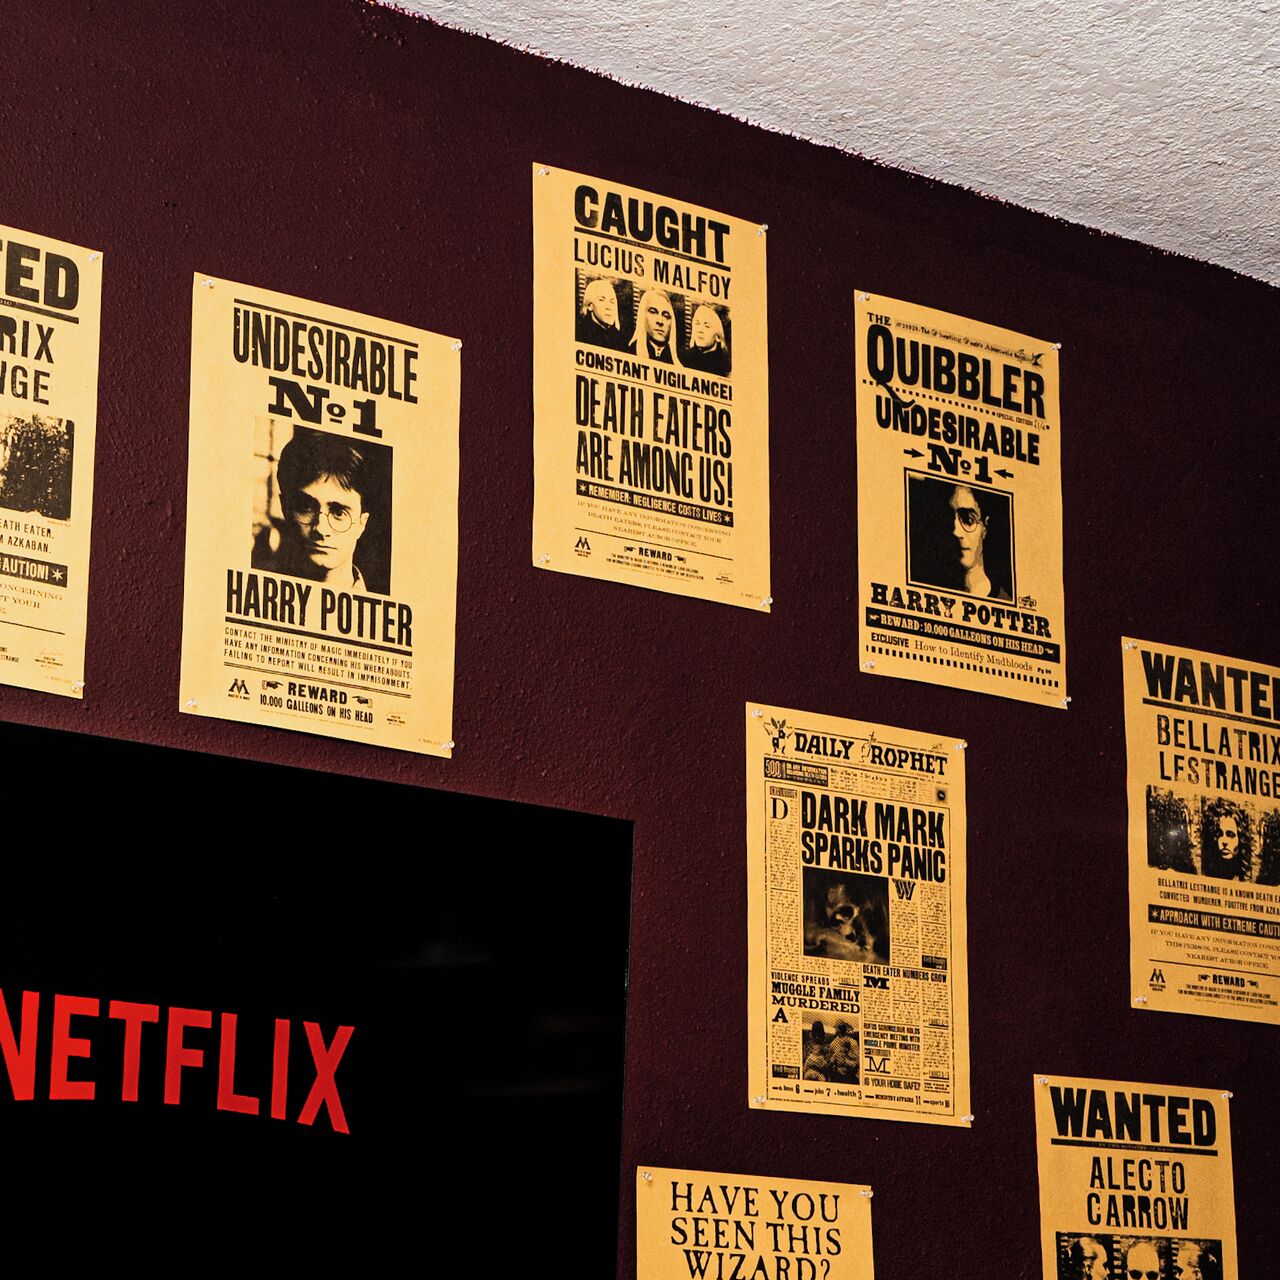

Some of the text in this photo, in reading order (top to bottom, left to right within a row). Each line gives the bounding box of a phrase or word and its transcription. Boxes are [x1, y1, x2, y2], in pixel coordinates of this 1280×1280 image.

[574, 184, 730, 264] CAUGHT
[574, 237, 731, 300] LUCIUS MALFOY
[866, 311, 892, 327] THE
[232, 306, 419, 405] UNDESIRABLE
[575, 349, 733, 401] CONSTANT VIGILANCE!
[866, 323, 1046, 420] QUIBBLER
[575, 374, 732, 459] DEATH EATERS
[875, 394, 1040, 466] UNDESIRABLE
[576, 430, 733, 509] ARE AMONG US!
[678, 503, 701, 518] COSTS
[702, 508, 722, 523] LIVES
[638, 546, 673, 562] REWARD
[226, 568, 413, 648] HARRY POTTER
[870, 582, 1052, 639] HARRY POTTER
[871, 631, 910, 648] EXCLUSIVE
[287, 681, 348, 705] REWARD
[794, 732, 855, 761] DAILY
[801, 790, 946, 849] DARK MARK
[801, 830, 946, 884] SPARKS PANIC
[1159, 909, 1199, 926] APPROACH
[1200, 914, 1221, 929] WITH
[1222, 917, 1257, 934] EXTREME
[771, 980, 861, 1003] MUGGLE FAMILY
[1212, 973, 1246, 988] REWARD
[771, 994, 861, 1014] MURDERED
[1049, 1085, 1217, 1147] WANTED
[1089, 1156, 1186, 1195] ALECTO
[670, 1181, 840, 1223] HAVE YOU
[1086, 1192, 1189, 1231] CARROW
[670, 1216, 842, 1256] SEEN THIS
